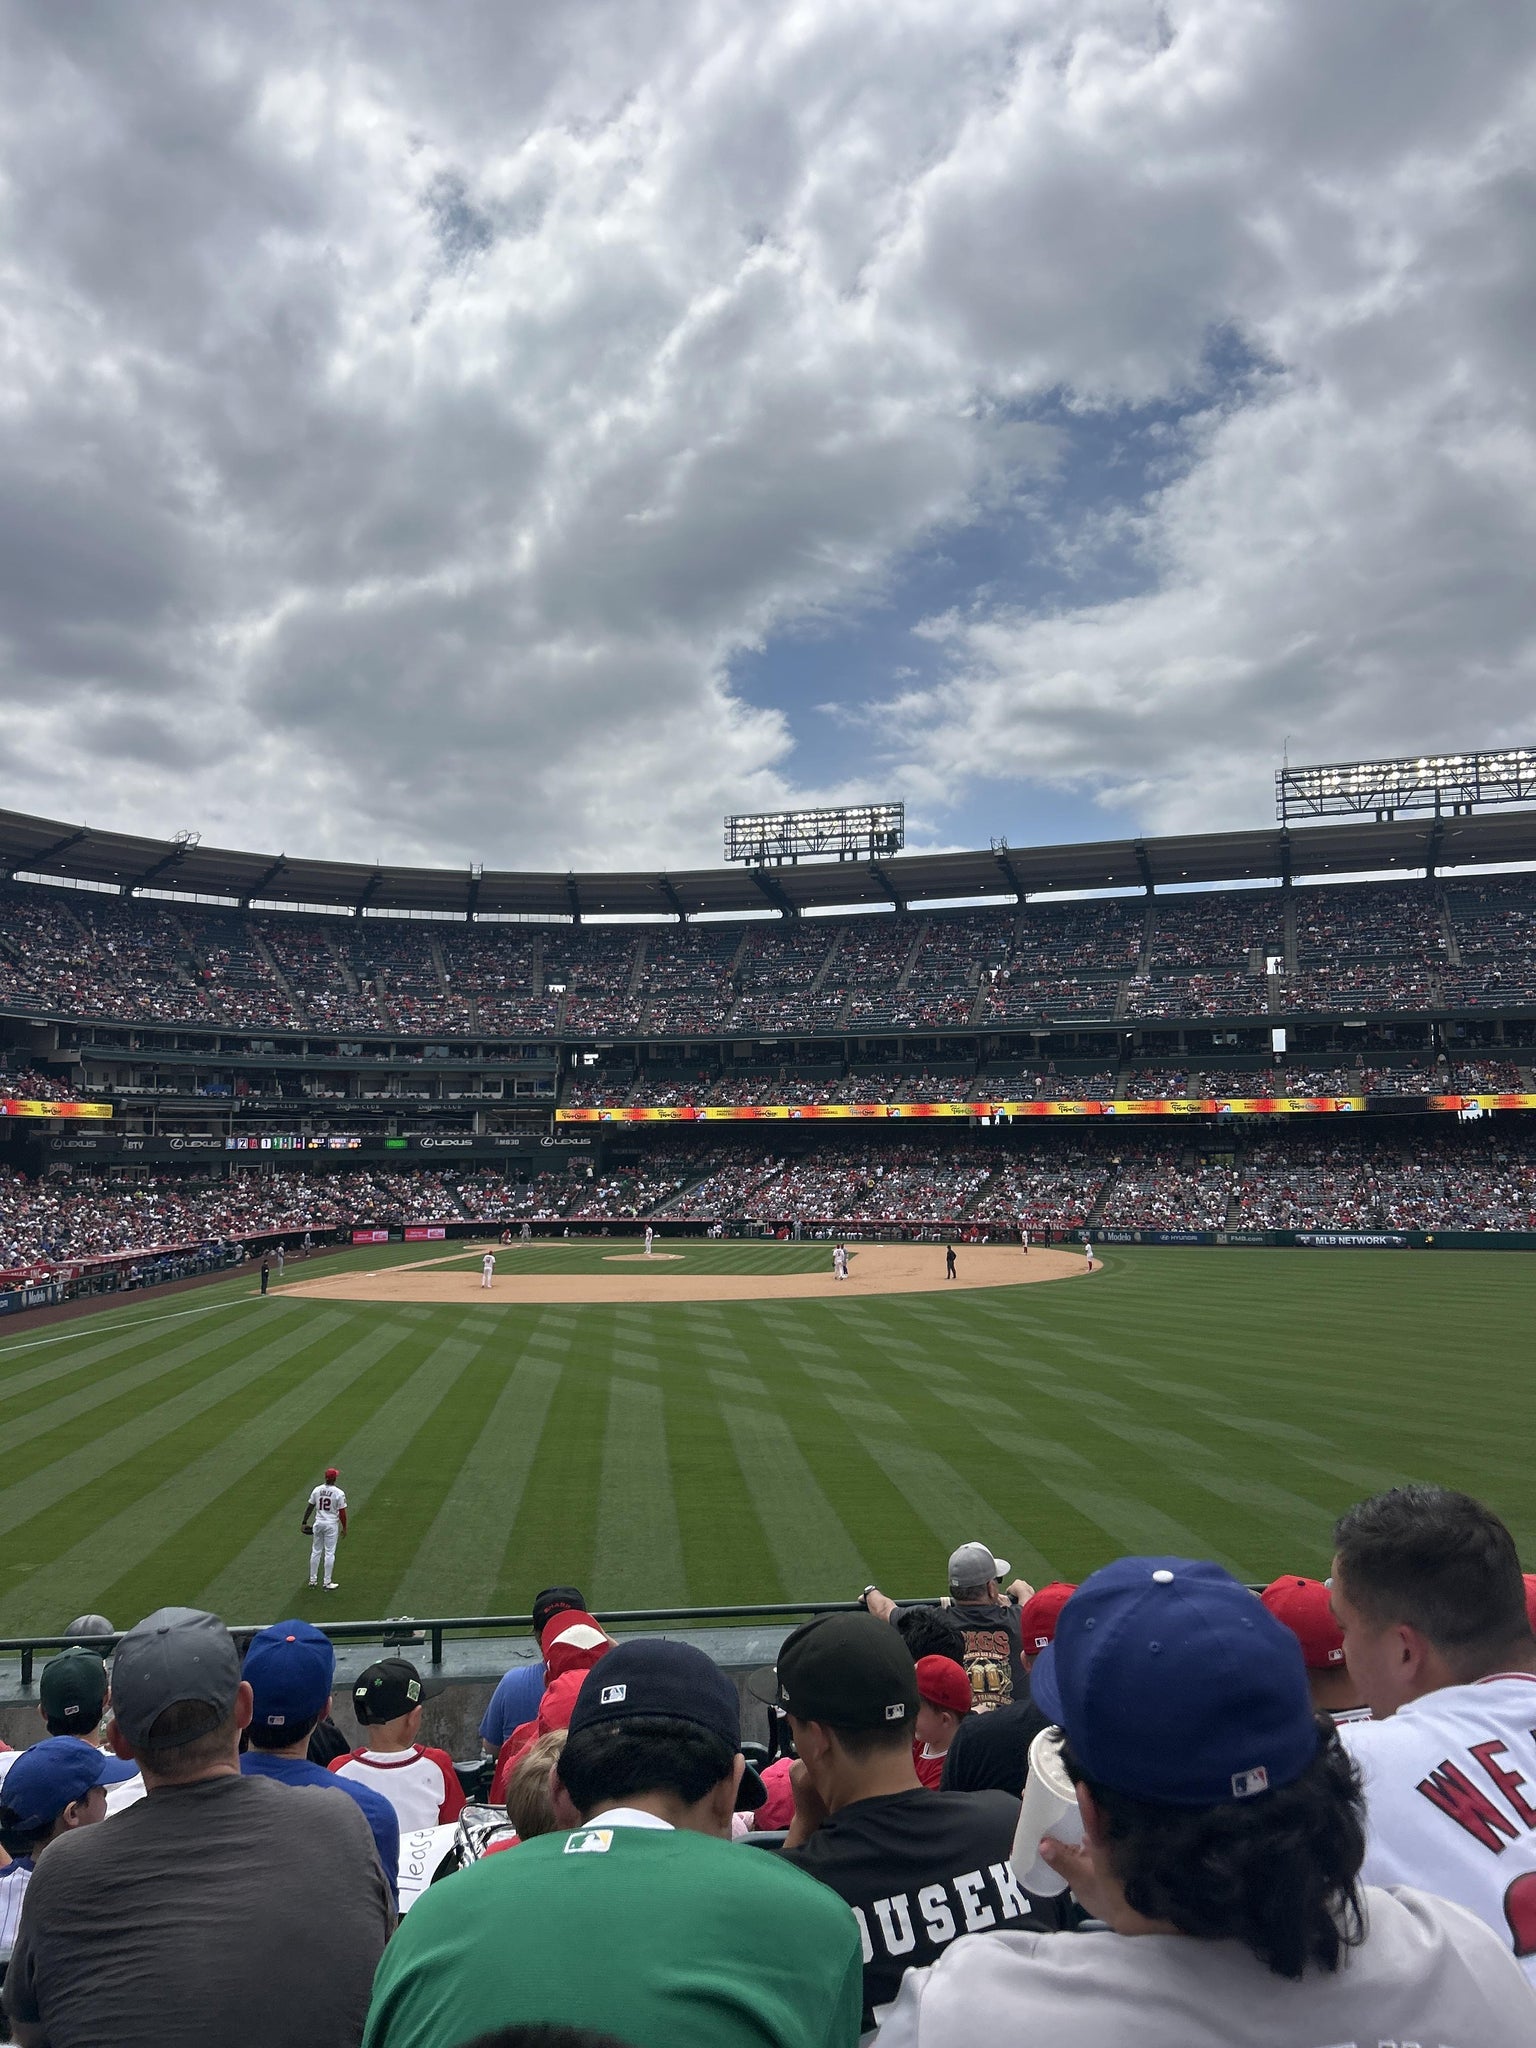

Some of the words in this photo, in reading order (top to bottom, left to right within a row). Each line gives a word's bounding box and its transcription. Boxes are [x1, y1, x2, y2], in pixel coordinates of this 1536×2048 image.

[185, 1140, 222, 1148] LEXUS
[1107, 1232, 1132, 1241] Modelo
[1315, 1236, 1336, 1245] MLB
[1338, 1236, 1388, 1245] NETWORK
[318, 1497, 332, 1511] 12
[961, 1630, 1010, 1658] IGS
